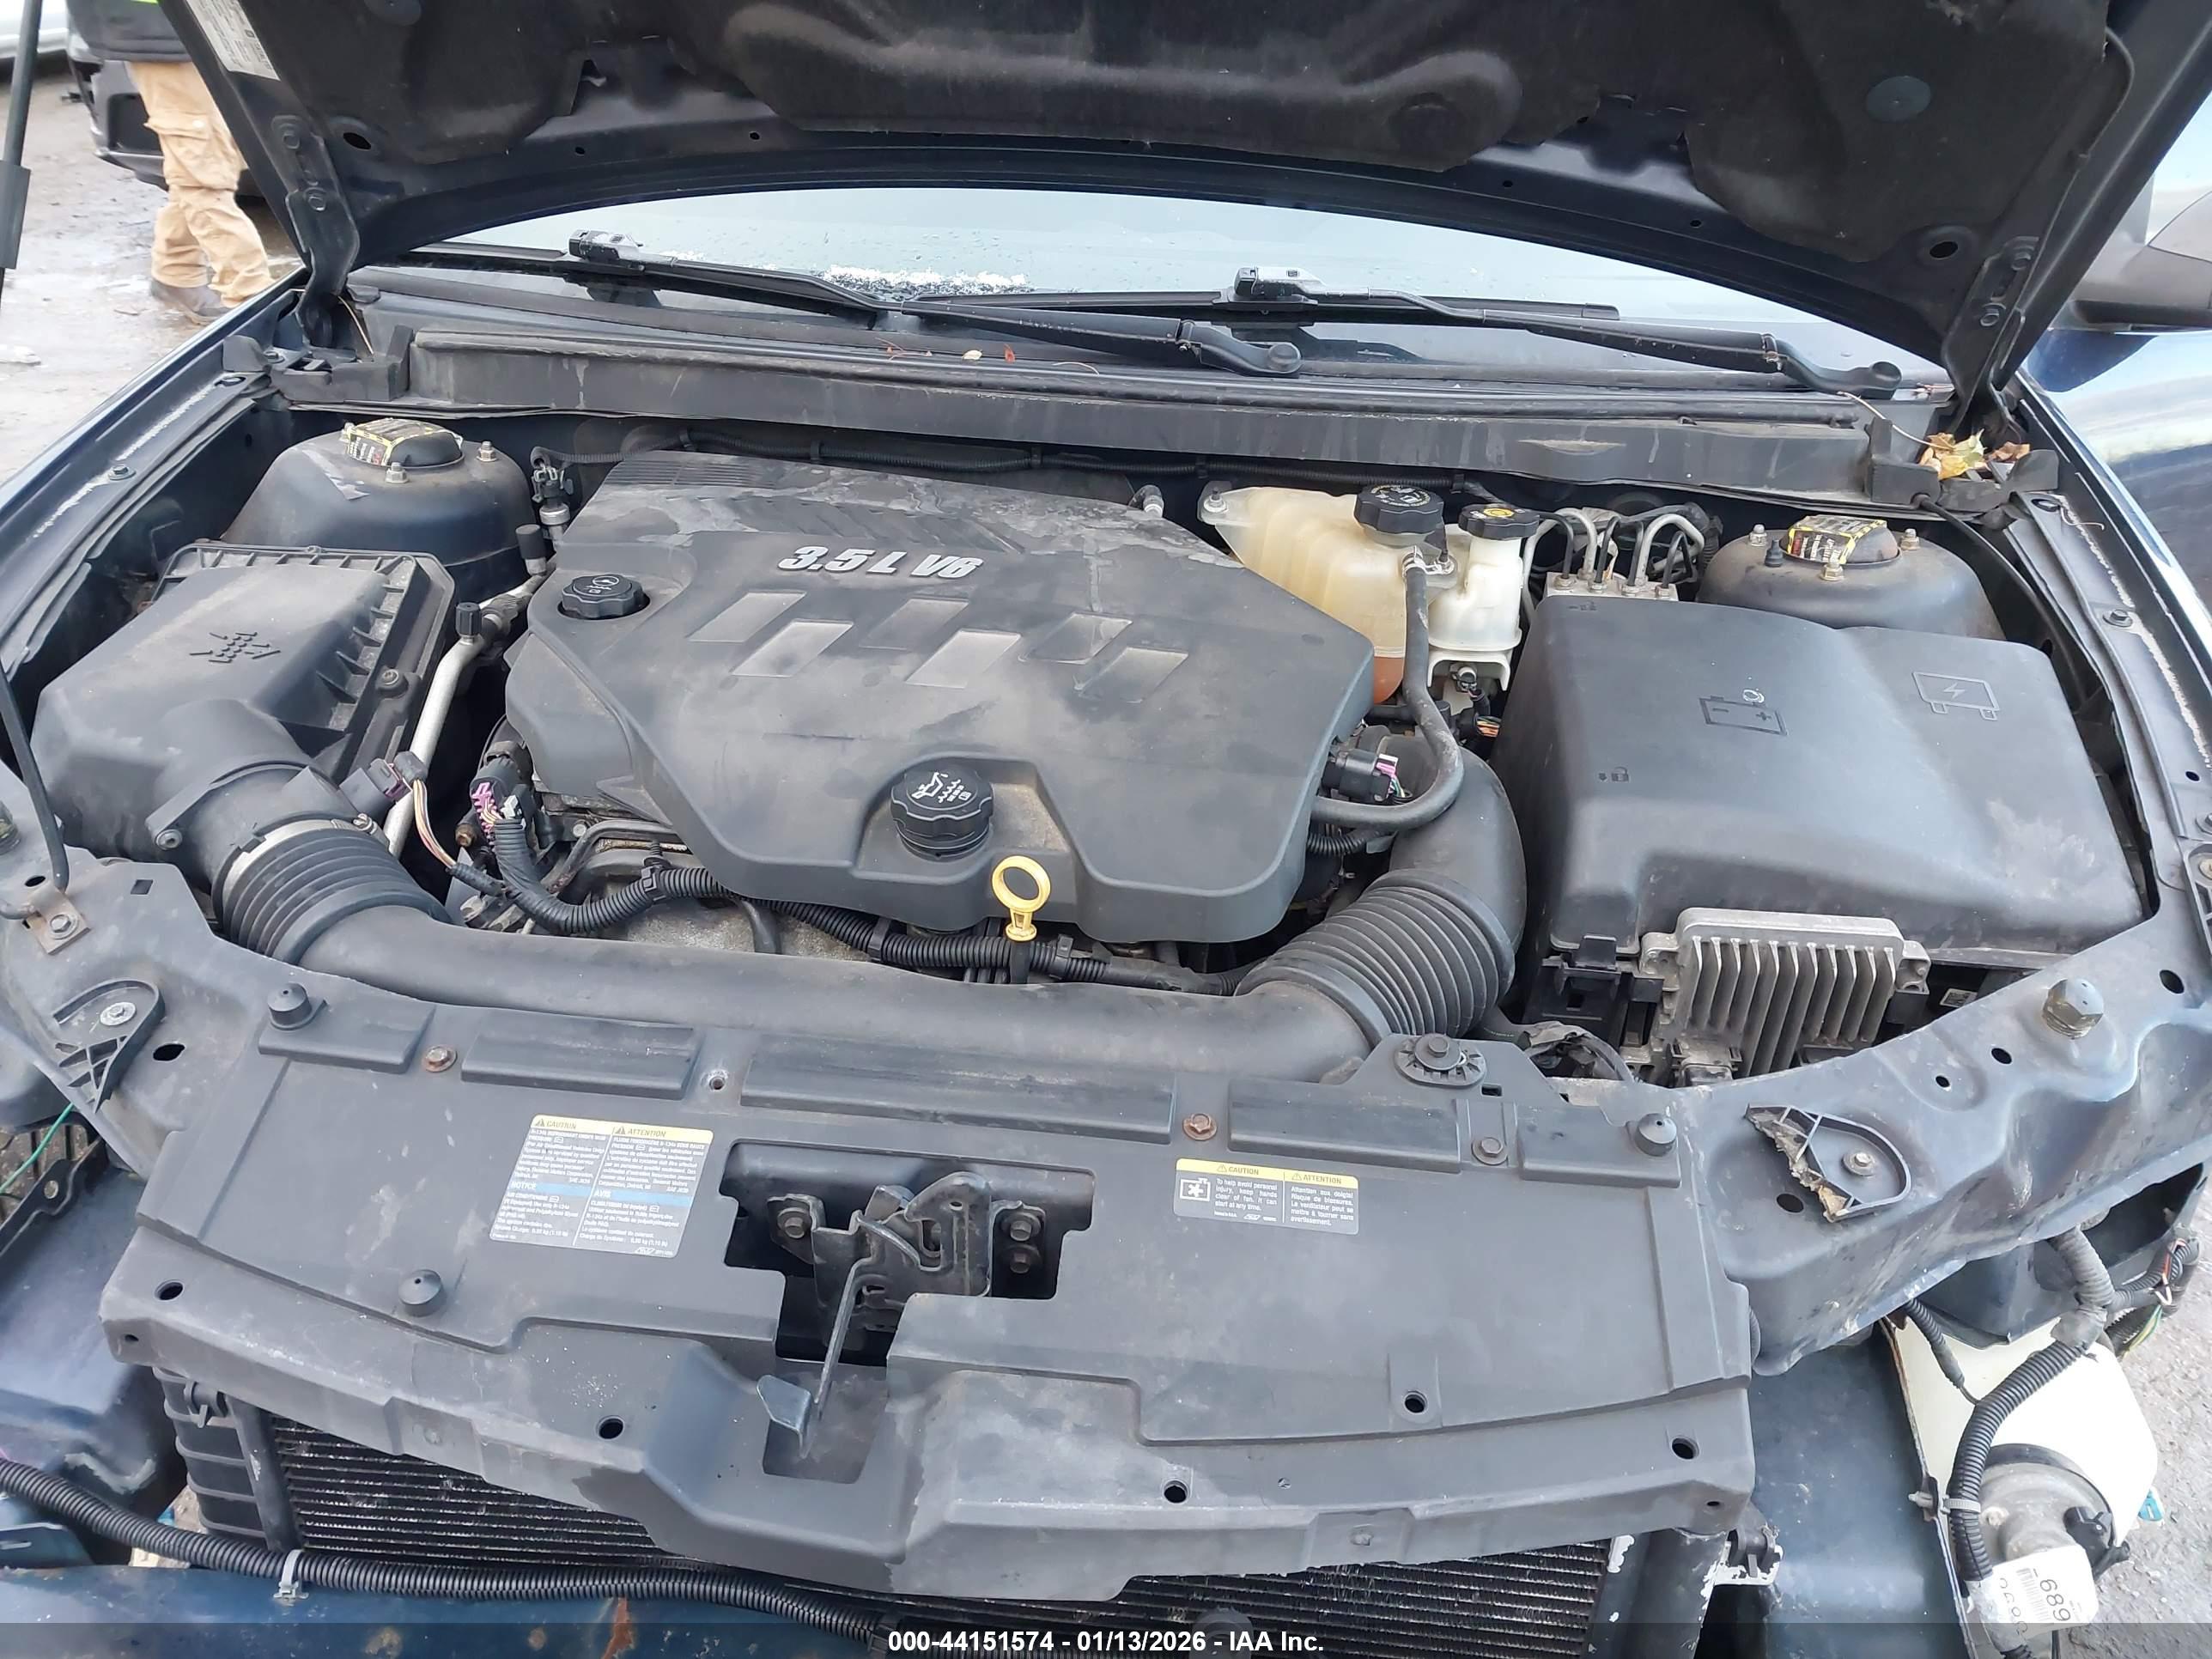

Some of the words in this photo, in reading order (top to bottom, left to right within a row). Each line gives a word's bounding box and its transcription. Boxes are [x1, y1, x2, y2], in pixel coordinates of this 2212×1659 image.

[910, 554, 983, 579] V6
[545, 1120, 578, 1129] CAUTION
[627, 1127, 666, 1138] ATTENTION
[1228, 1166, 1258, 1175] CAUTION
[510, 1179, 538, 1189] NOTICE
[1303, 1174, 1341, 1184] ATTENTION
[593, 1188, 612, 1198] AVIS
